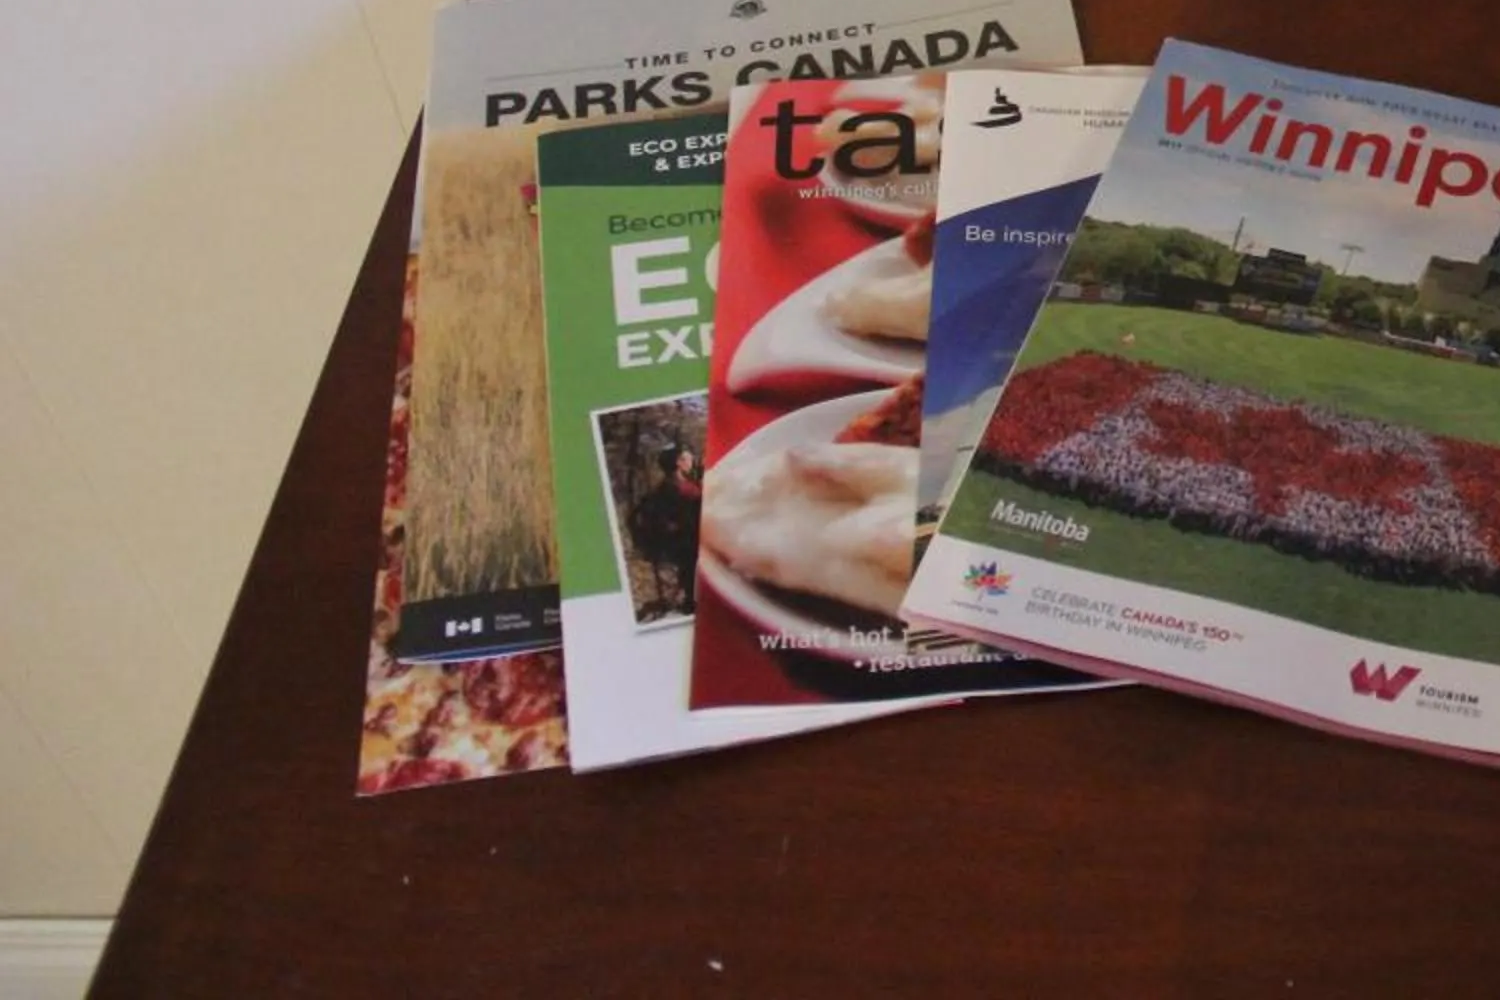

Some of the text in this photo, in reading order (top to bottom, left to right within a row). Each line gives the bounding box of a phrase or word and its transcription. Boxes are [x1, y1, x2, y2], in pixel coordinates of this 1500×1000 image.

[625, 23, 877, 69] TIME TO CONNECT
[486, 20, 1019, 128] PARKS CANADA
[629, 139, 678, 157] ECO
[654, 151, 728, 172] & EXP
[759, 99, 945, 181] ta
[609, 208, 722, 234] Becom
[965, 225, 995, 242] Be
[611, 236, 721, 326] E
[991, 499, 1090, 542] Manitoba
[1025, 600, 1102, 629] BIRTHDAY
[1105, 620, 1123, 634] IN
[1127, 622, 1208, 652] WINNIPEG
[1031, 586, 1116, 615] CELEBRATE
[1121, 607, 1199, 634] CANADA'S
[759, 627, 842, 650] what's
[849, 625, 893, 648] hot
